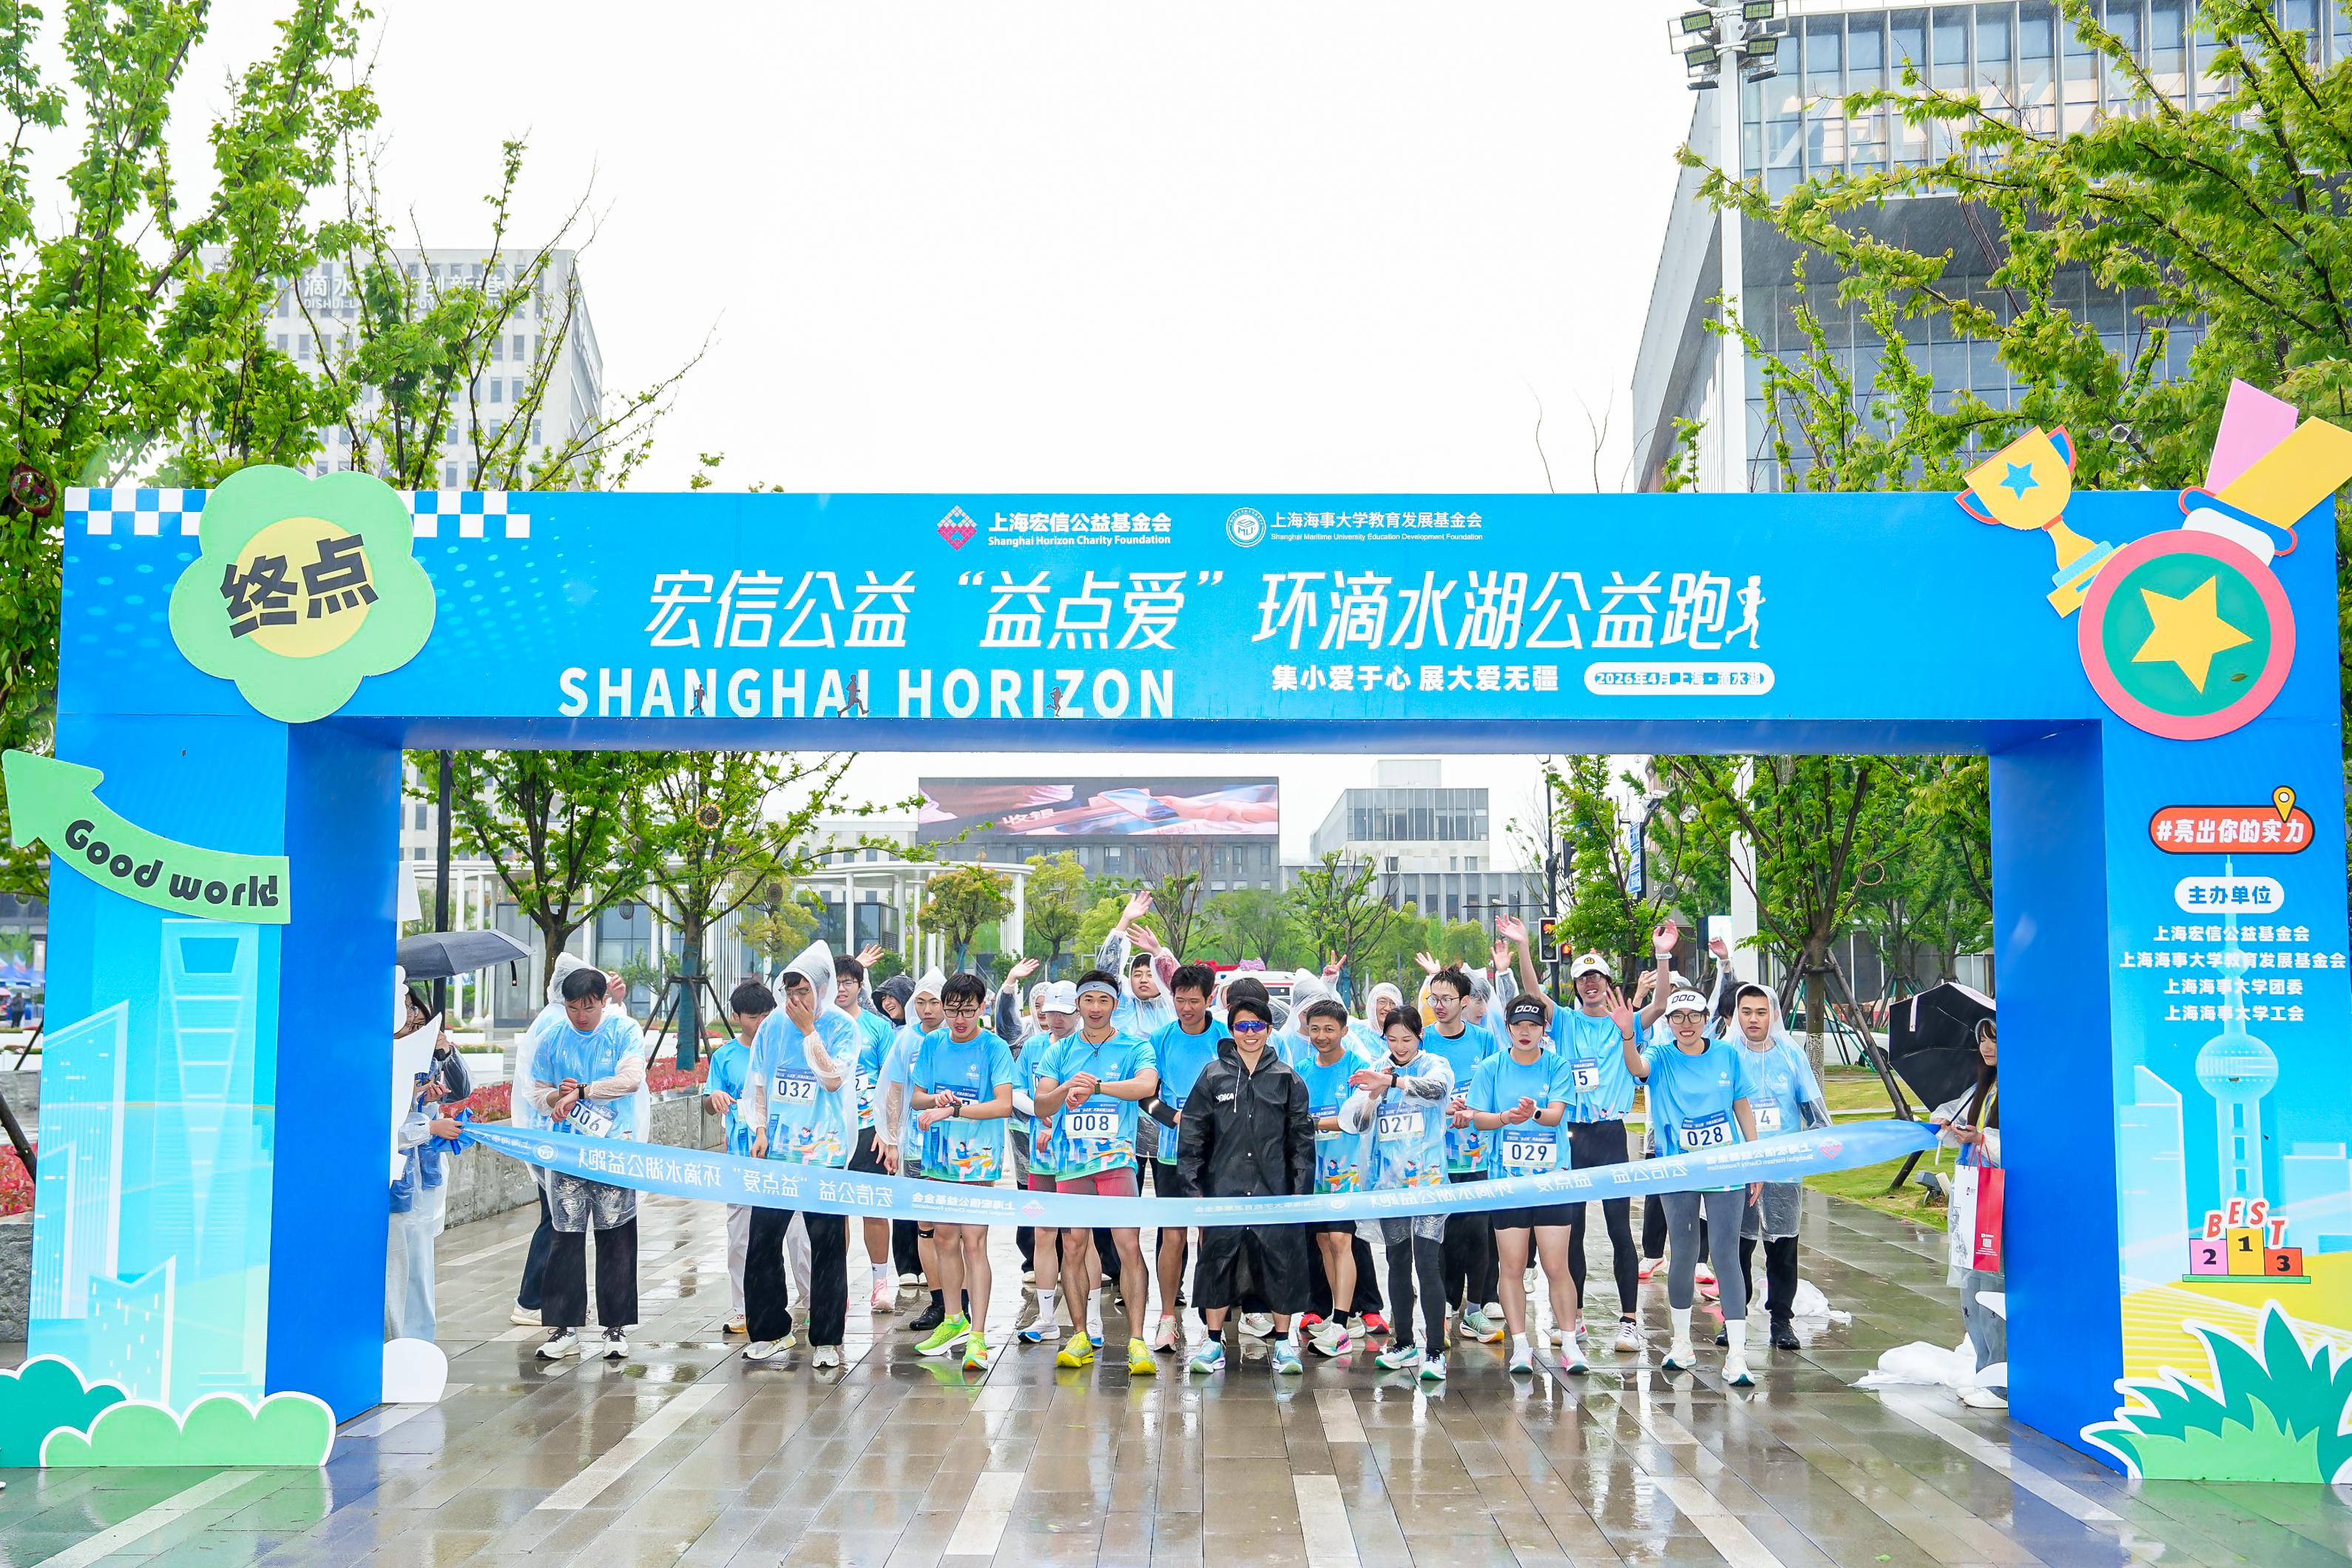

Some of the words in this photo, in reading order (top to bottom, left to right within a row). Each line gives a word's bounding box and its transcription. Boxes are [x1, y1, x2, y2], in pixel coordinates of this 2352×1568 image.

[988, 512, 1172, 533] 上海宏信公益基金会
[1270, 512, 1482, 529] 上海海事大学教育发展基金会
[988, 536, 1034, 547] Shanghai
[1036, 536, 1075, 546] Horizon
[1076, 535, 1112, 547] Charity
[1115, 535, 1171, 544] Foundation
[1271, 533, 1302, 541] Shanghai
[1334, 533, 1366, 541] University
[1402, 533, 1445, 541] Development
[220, 534, 379, 638] 终点
[644, 569, 916, 649] 宏信公益
[1251, 570, 1731, 650] 环滴水湖公益跑
[1271, 664, 1410, 691] 集小爱于心
[1419, 664, 1558, 692] 展大爱无疆
[558, 667, 869, 718] SHANGHAI
[898, 667, 1175, 718] HORIZON
[2156, 818, 2305, 843] #亮出你的实力
[65, 820, 164, 888] Good
[2188, 886, 2271, 905] 主办单位
[2153, 926, 2310, 942] 上海宏信公益基金会
[2119, 952, 2346, 969] 上海海事大学教育发展基金会
[2163, 979, 2304, 996] 上海海事大学团委
[2165, 1005, 2305, 1022] 上海海事大学工会
[778, 1081, 811, 1098] 032
[570, 1103, 602, 1132] 006
[1073, 1115, 1109, 1131] 008
[1379, 1115, 1413, 1134] 027
[1687, 1126, 1723, 1146] 028
[1512, 1144, 1547, 1161] 029
[2206, 1201, 2285, 1246] BEST
[2203, 1249, 2217, 1265] 2
[2238, 1236, 2254, 1252] 1
[2277, 1255, 2291, 1271] 3
